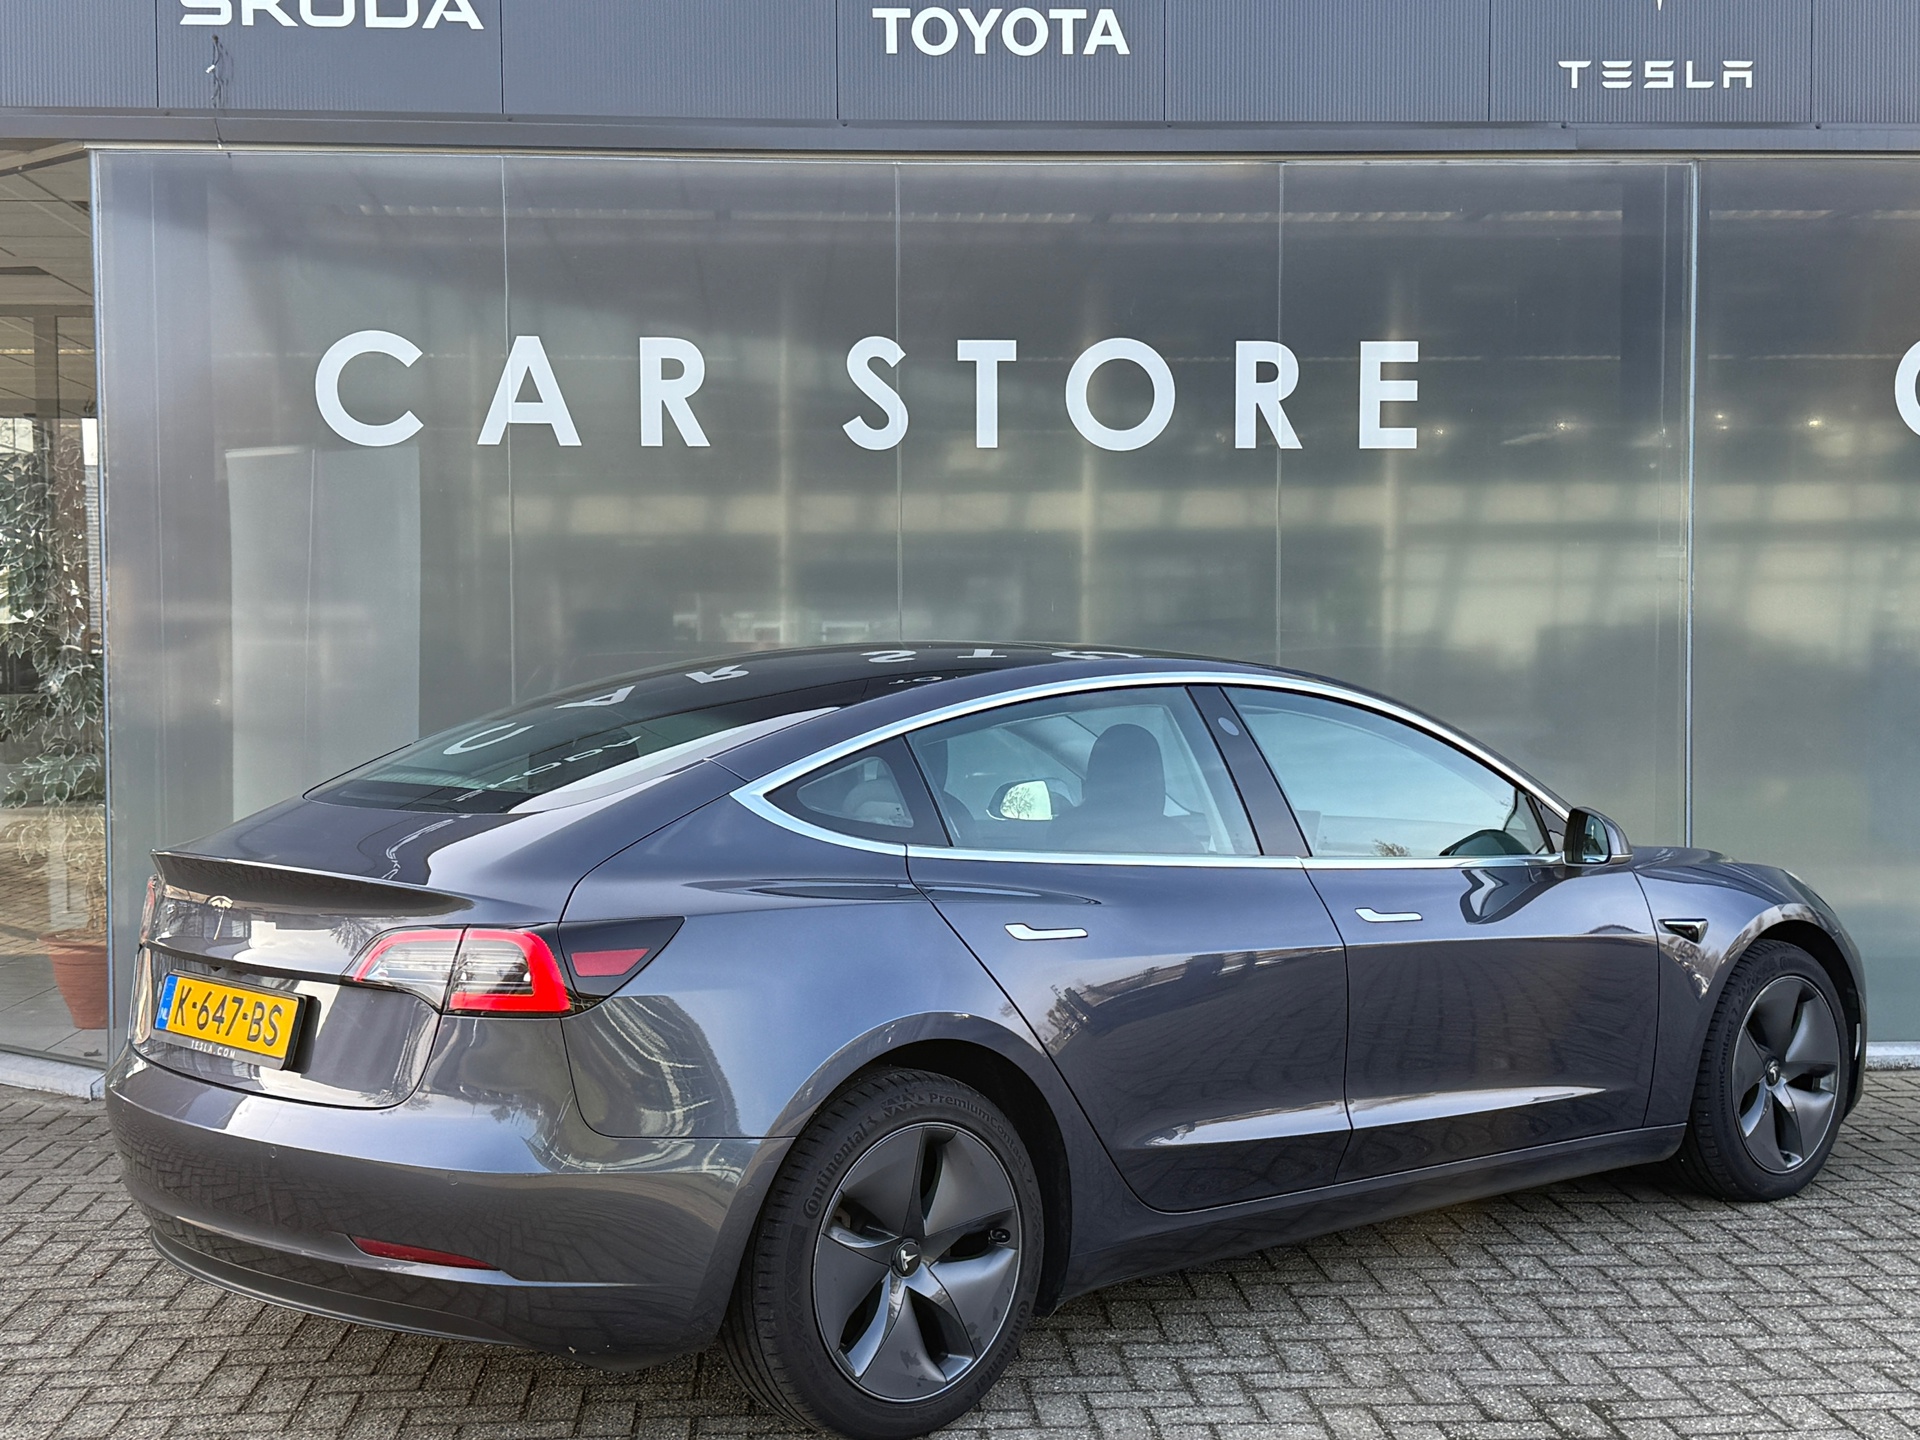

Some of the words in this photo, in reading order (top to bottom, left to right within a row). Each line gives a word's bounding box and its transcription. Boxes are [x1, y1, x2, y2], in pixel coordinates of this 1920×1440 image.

[872, 6, 1131, 57] TOYOTA
[1558, 60, 1753, 89] TESLA
[315, 329, 711, 447] CAR
[842, 336, 1419, 451] STORE
[160, 1007, 169, 1021] NL
[174, 985, 283, 1047] K-647-BS
[190, 1040, 237, 1059] TESLA.COM
[929, 1092, 1030, 1171] PremiumContact
[803, 1122, 870, 1220] Continental
